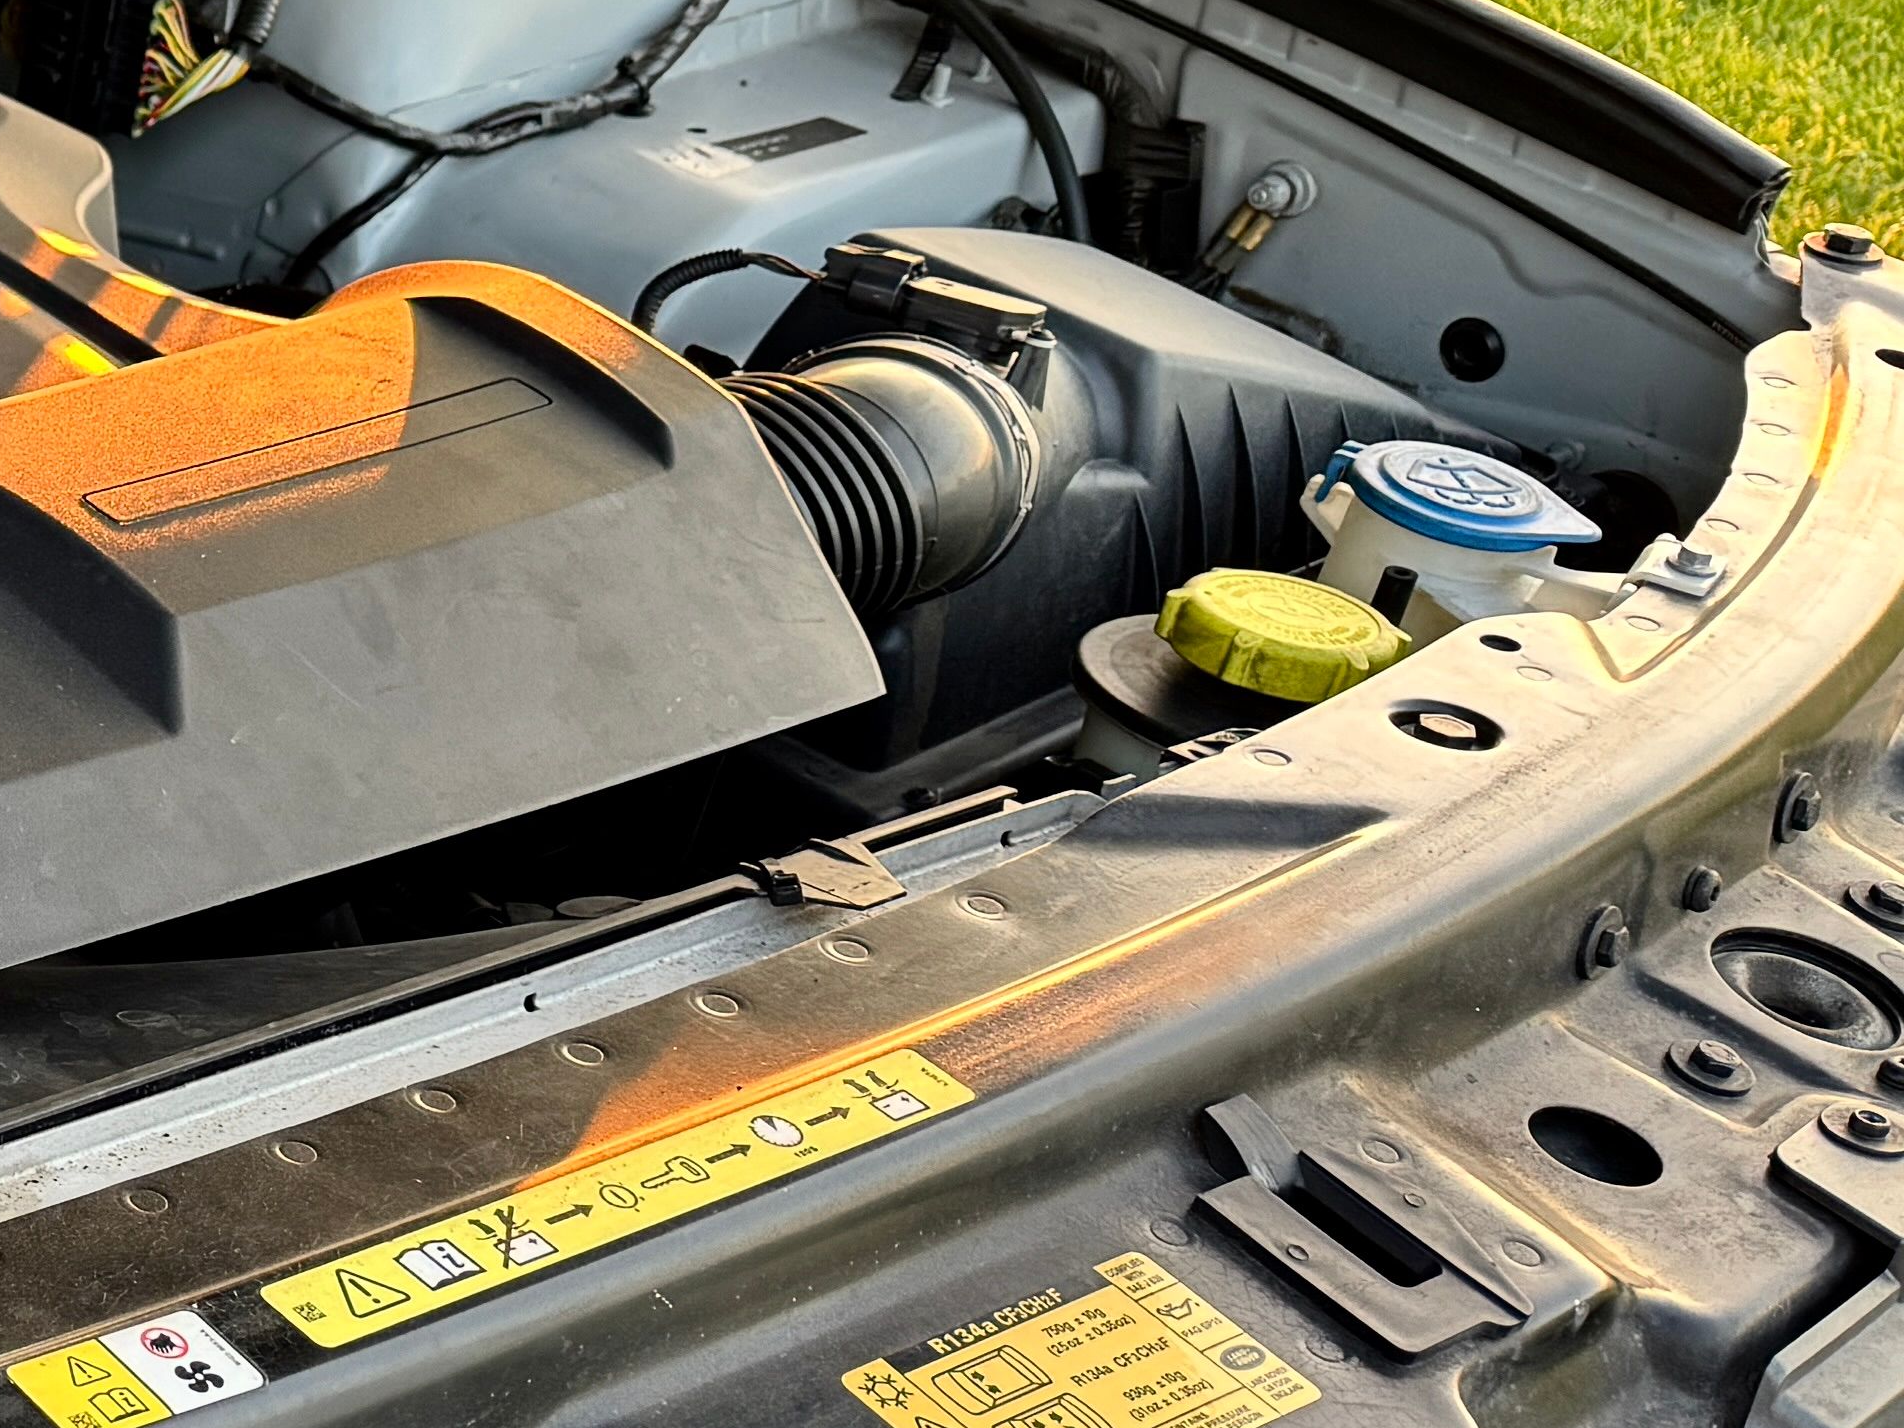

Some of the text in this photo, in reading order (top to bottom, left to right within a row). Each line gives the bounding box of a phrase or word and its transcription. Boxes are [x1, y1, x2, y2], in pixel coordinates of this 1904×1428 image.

[927, 1320, 999, 1354] R134a
[1041, 1322, 1075, 1339] 750g
[1070, 1365, 1114, 1387] R134a
